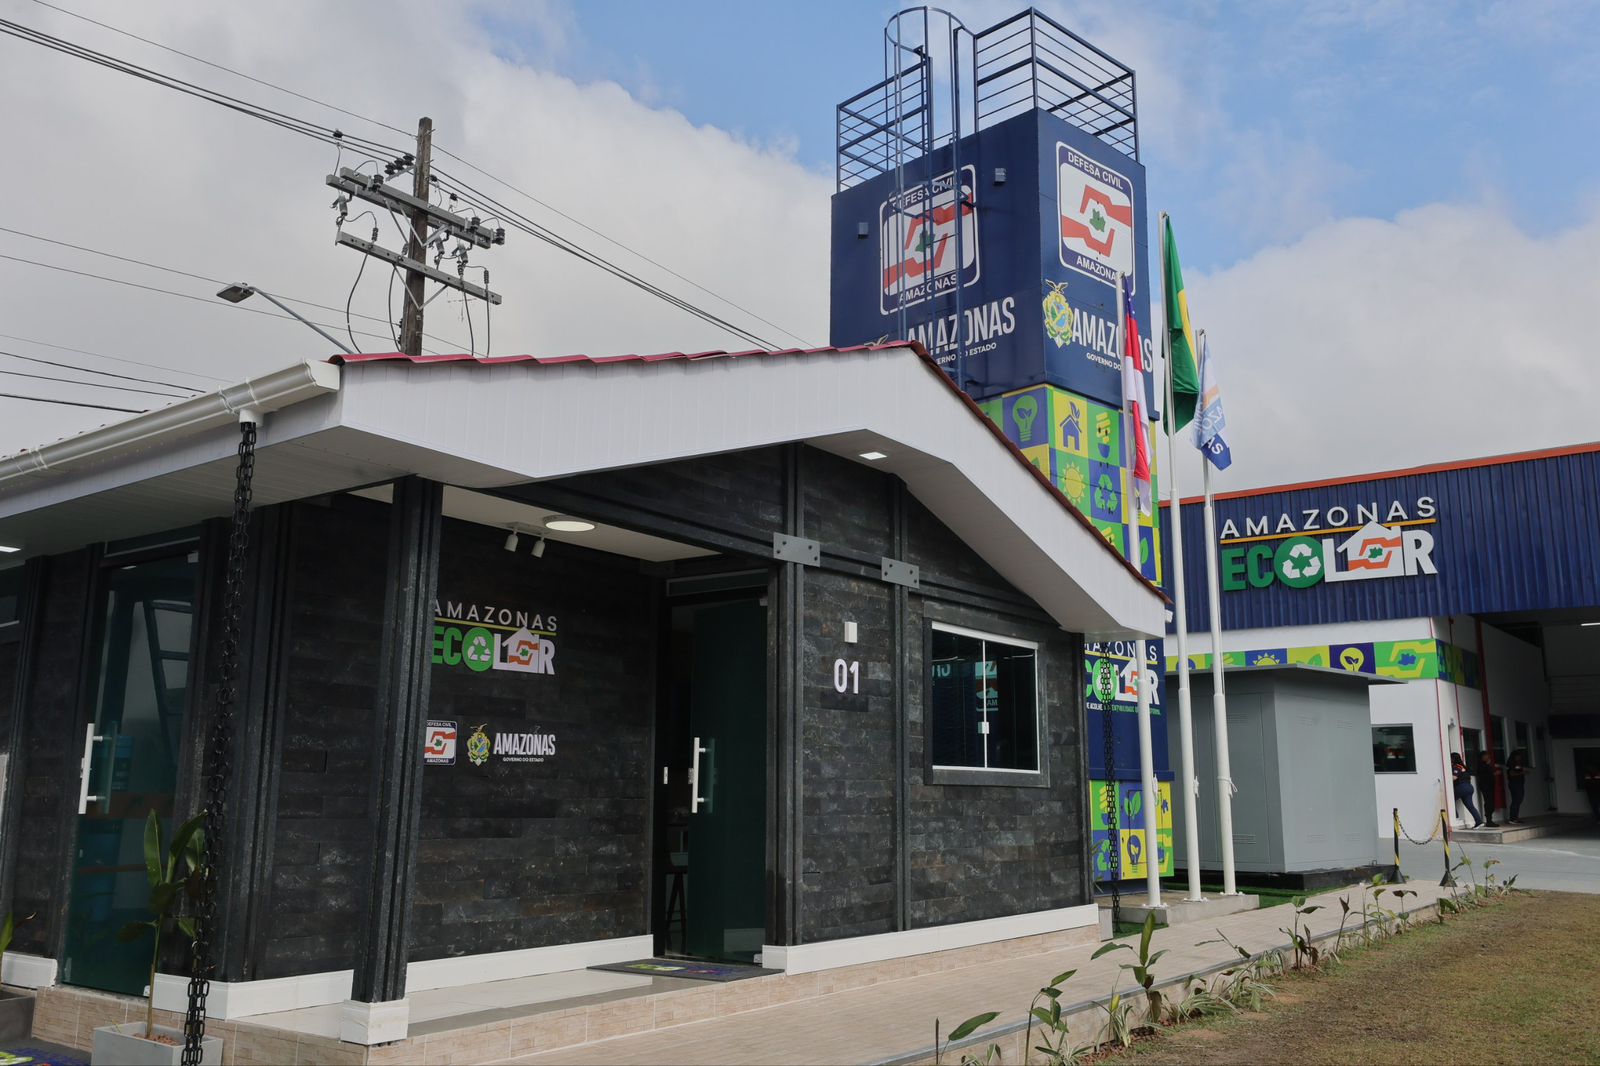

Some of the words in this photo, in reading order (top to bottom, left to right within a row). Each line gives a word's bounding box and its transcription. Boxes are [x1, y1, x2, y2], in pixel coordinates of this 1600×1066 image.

[1067, 151, 1101, 179] DEFESA
[1102, 171, 1123, 190] CIVIL
[1076, 255, 1117, 281] AMAZONA
[969, 342, 997, 356] ESTADO
[1086, 352, 1113, 368] GOVERNO
[1219, 496, 1437, 540] AMAZONAS
[833, 658, 860, 694] 01
[493, 732, 556, 756] AMAZONAS
